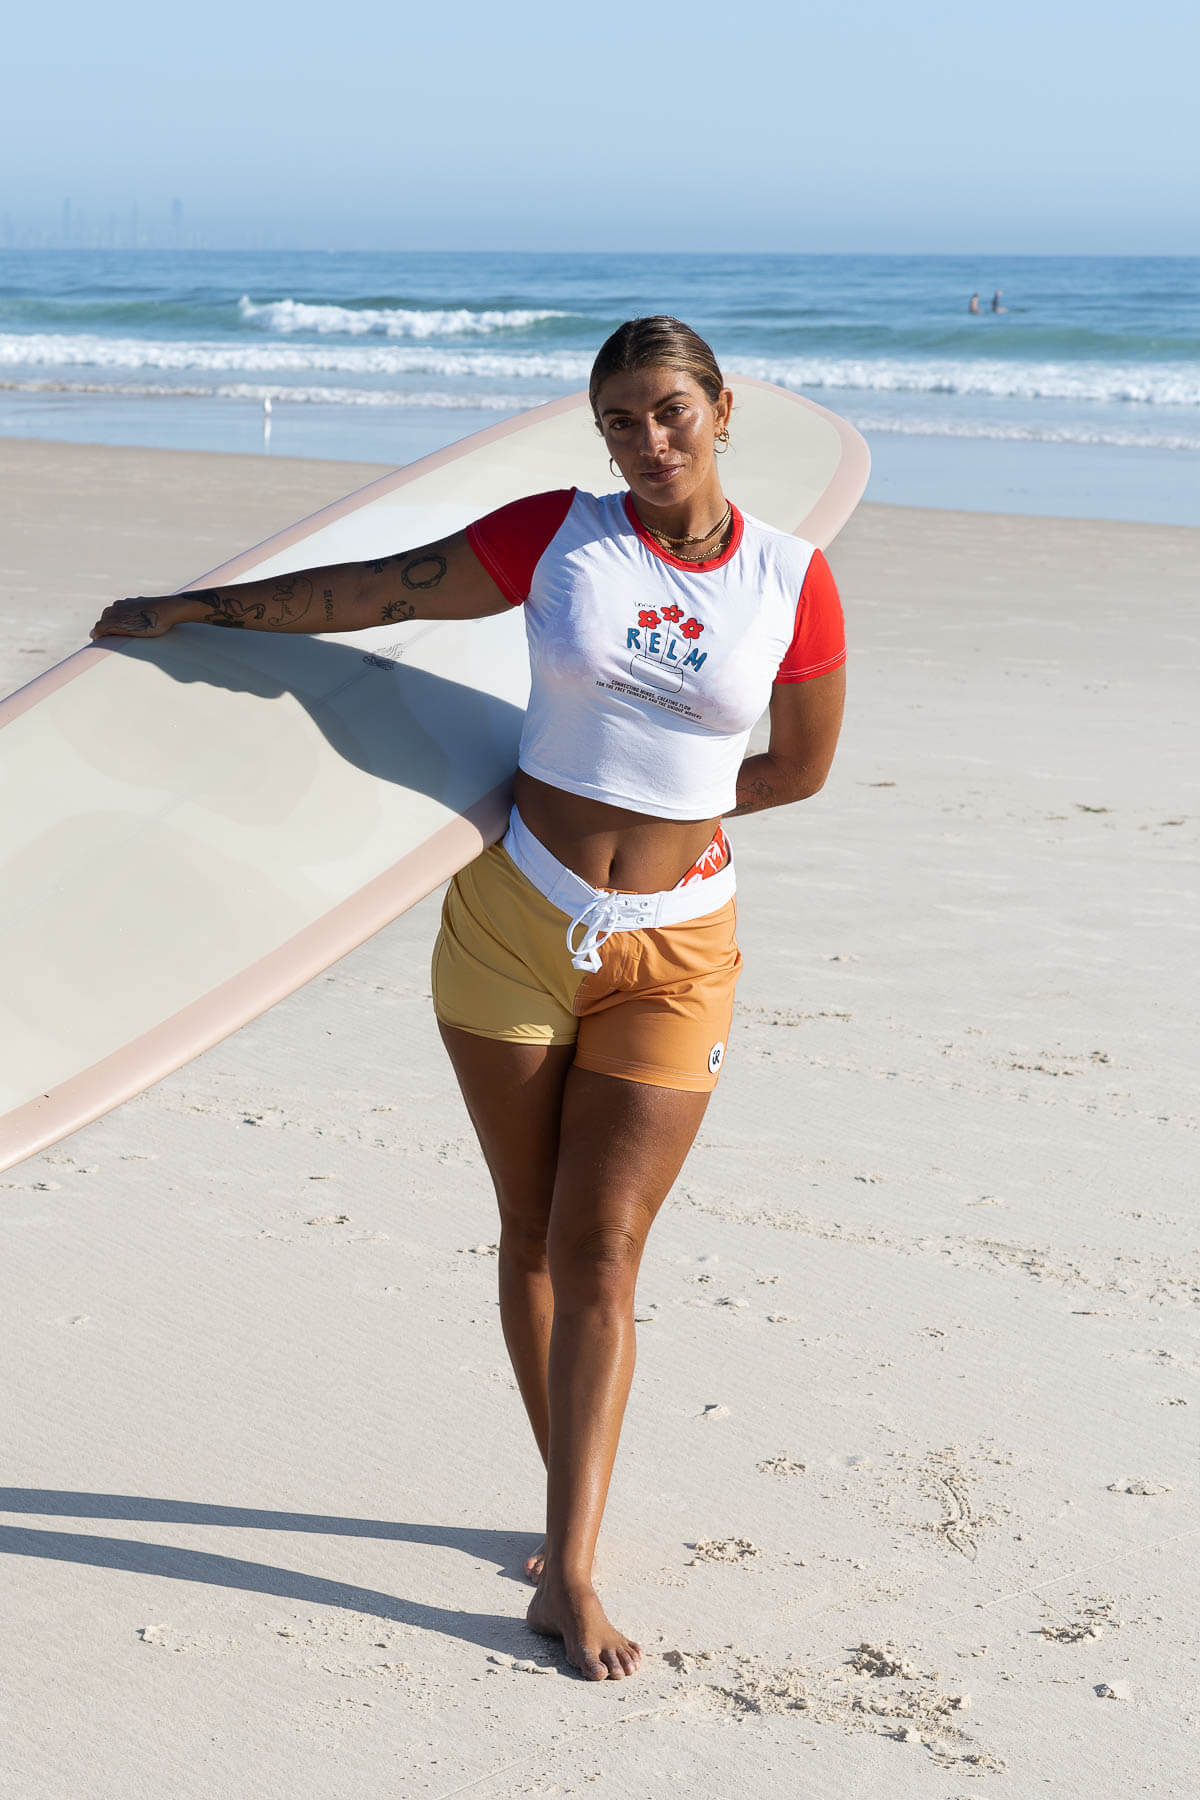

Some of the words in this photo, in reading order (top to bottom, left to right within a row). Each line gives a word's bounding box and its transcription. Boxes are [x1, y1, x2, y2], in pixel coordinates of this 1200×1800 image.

[626, 627, 708, 672] RELM
[611, 679, 640, 692] CONNECTING
[657, 695, 679, 707] CREATING
